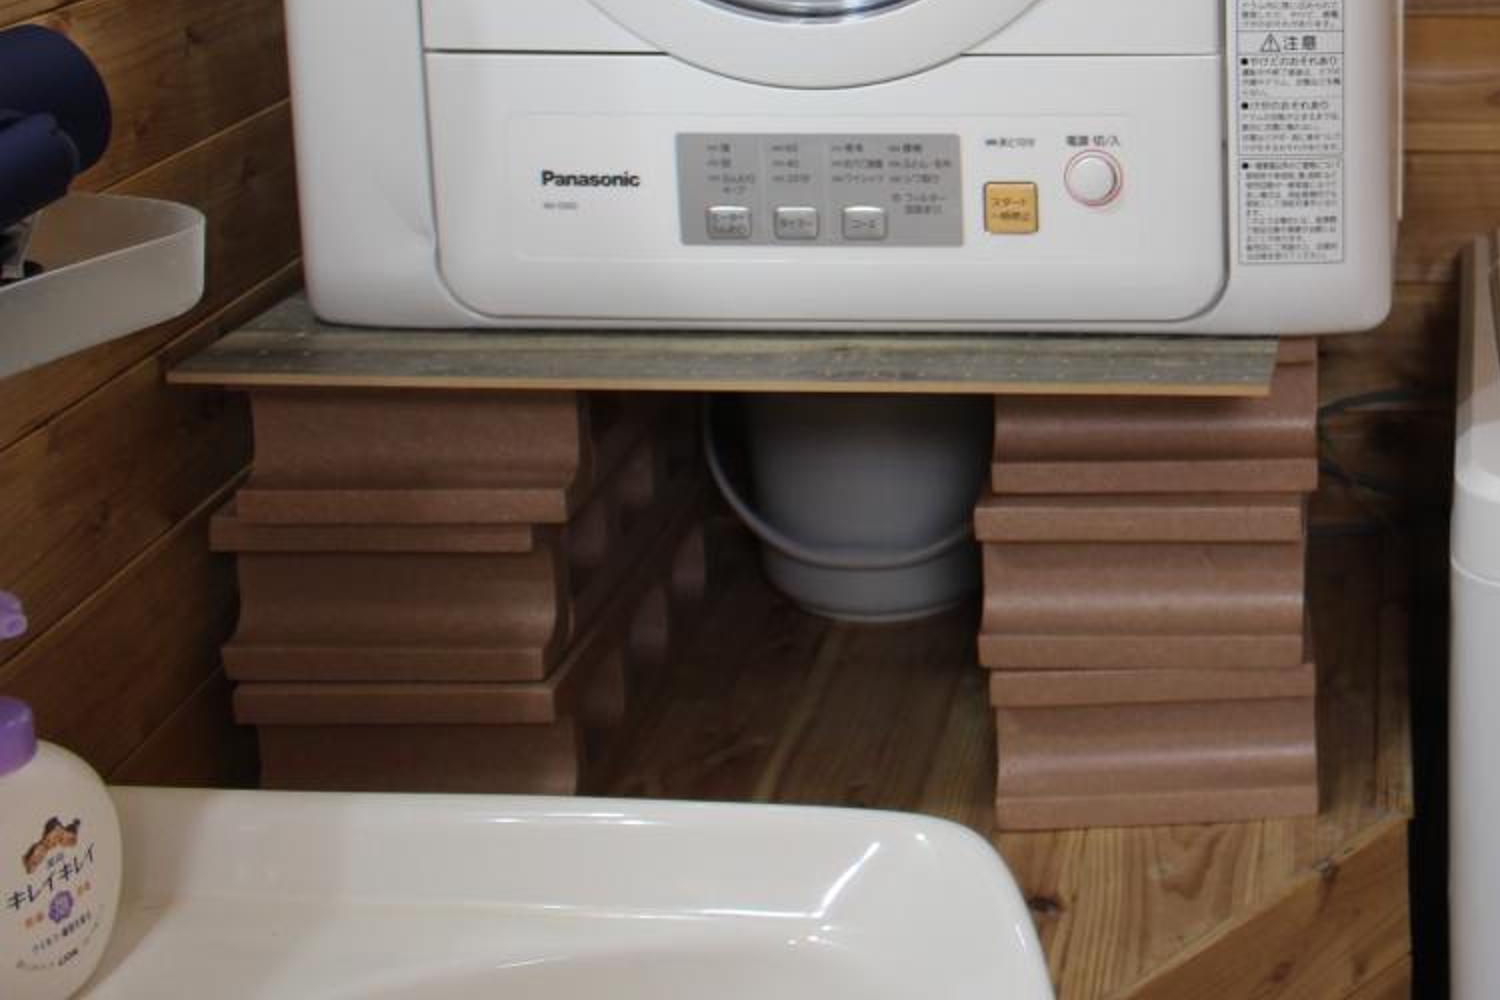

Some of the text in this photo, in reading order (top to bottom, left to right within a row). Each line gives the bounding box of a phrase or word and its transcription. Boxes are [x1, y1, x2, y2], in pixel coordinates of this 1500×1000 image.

[1284, 35, 1317, 51] 注意
[541, 169, 641, 187] Panasonic
[6, 842, 96, 911] キレイキレイ
